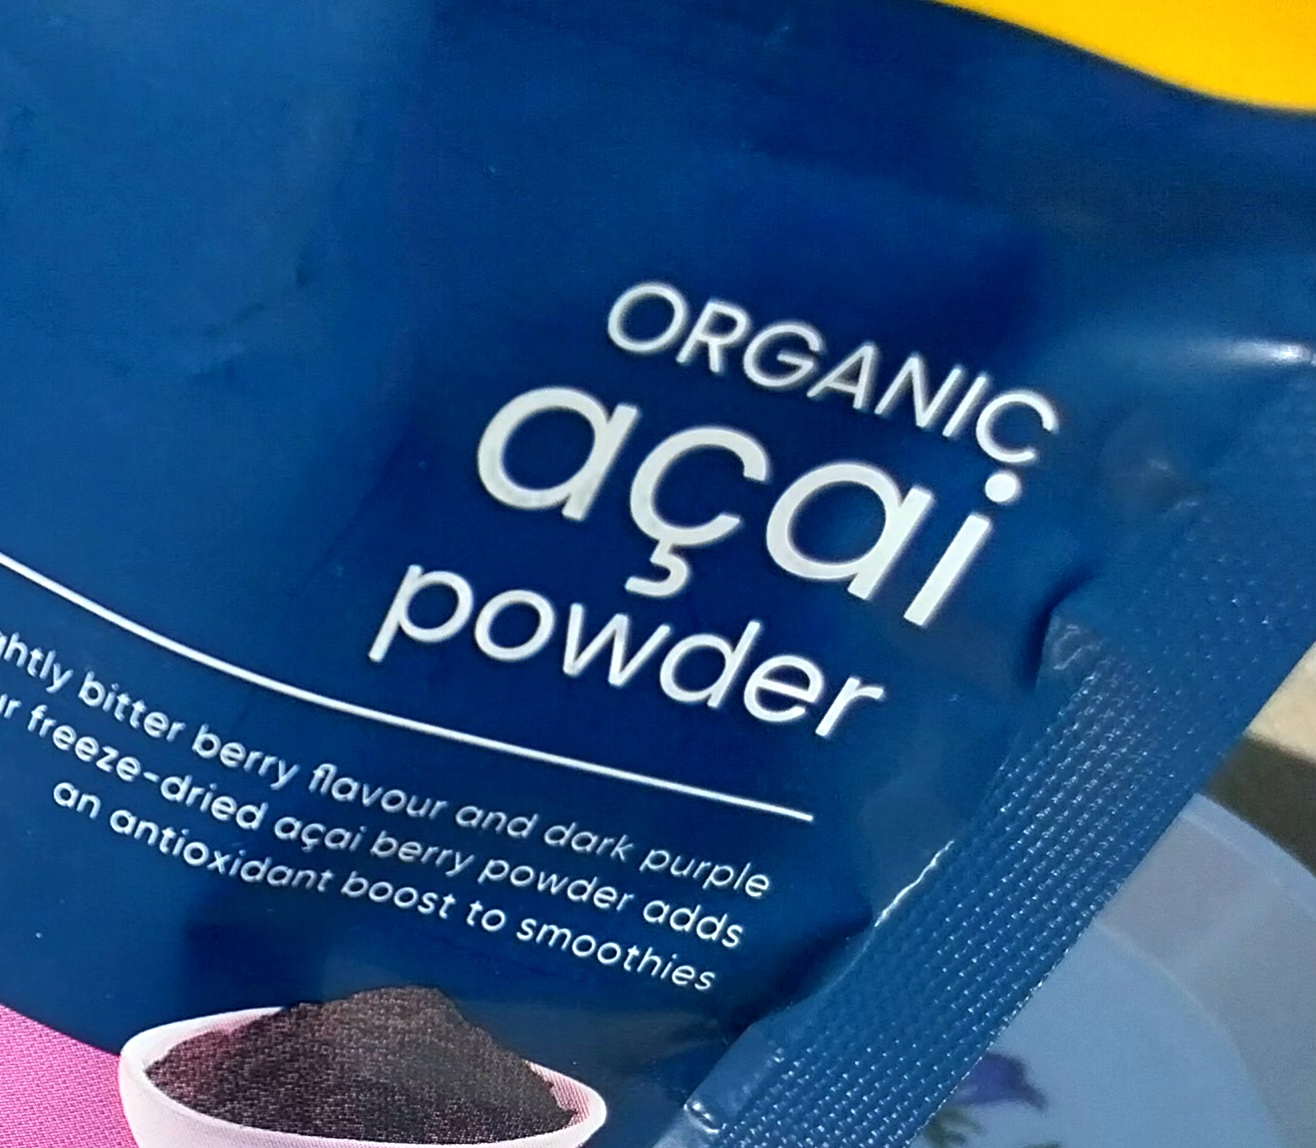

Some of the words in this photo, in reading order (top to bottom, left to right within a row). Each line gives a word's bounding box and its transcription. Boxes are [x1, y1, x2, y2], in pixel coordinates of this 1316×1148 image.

[607, 282, 1060, 464] ORGANIC
[478, 386, 1022, 628] açai
[368, 564, 886, 738] powder
[27, 706, 266, 830] freeze-dried
[274, 814, 367, 853] açai
[372, 829, 474, 876] berry
[478, 858, 634, 913] powder
[643, 899, 745, 949] adds
[53, 781, 101, 819] an
[110, 808, 333, 893] antioxidant
[340, 869, 456, 920] boost
[466, 899, 506, 932] to
[516, 915, 716, 992] smoothies
[78, 671, 186, 743] bitter
[192, 724, 300, 790] berry
[309, 763, 447, 820] flavour
[455, 804, 538, 839] and
[544, 821, 634, 862] dark
[640, 846, 770, 899] purple
